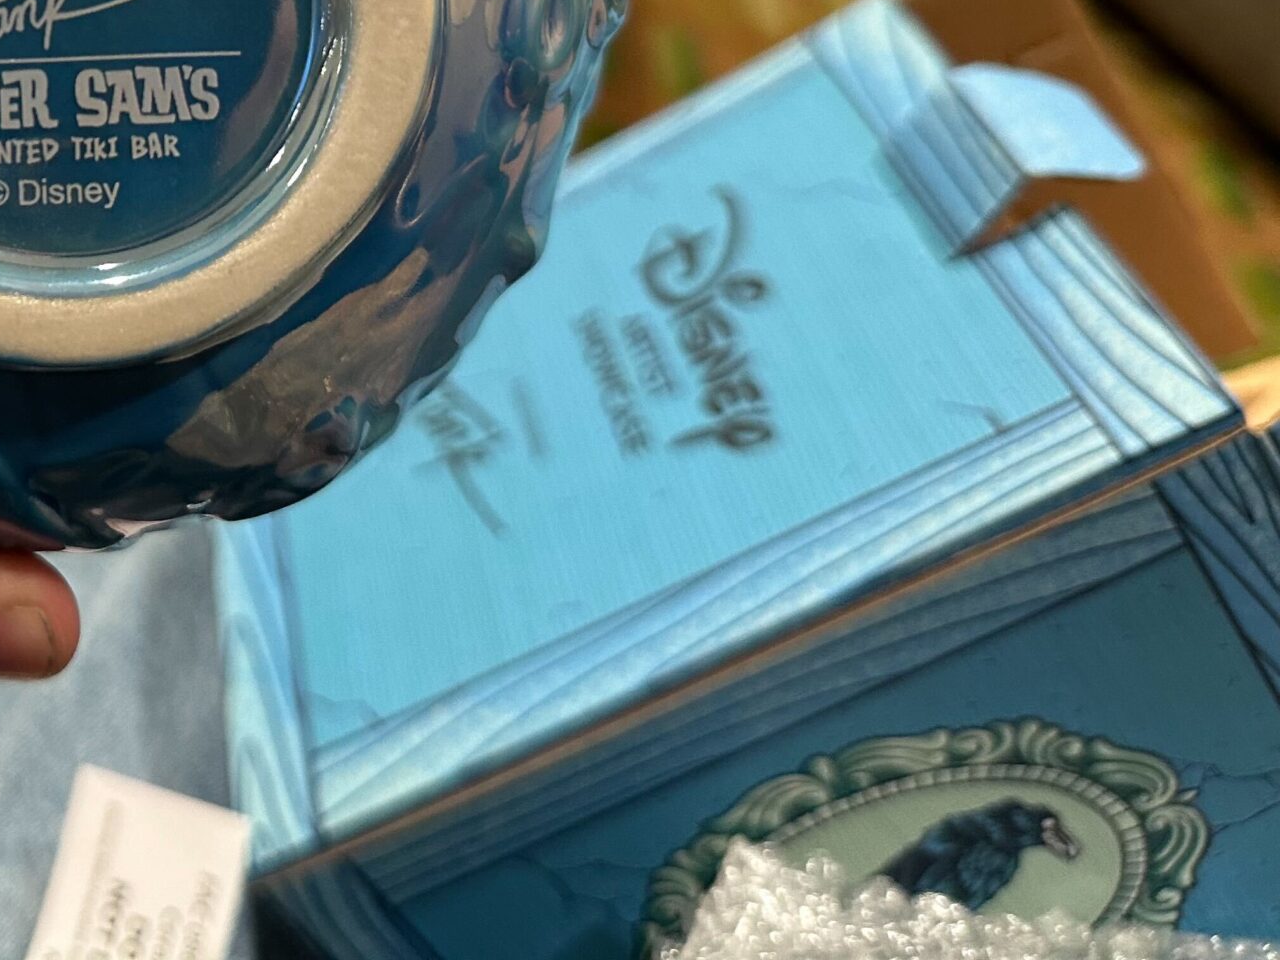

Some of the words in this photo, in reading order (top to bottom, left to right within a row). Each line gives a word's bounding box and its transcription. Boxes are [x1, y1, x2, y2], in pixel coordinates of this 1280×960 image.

[75, 64, 220, 128] SAM'S
[71, 135, 119, 161] TIKI
[131, 133, 181, 159] BAR
[18, 178, 121, 209] Disney
